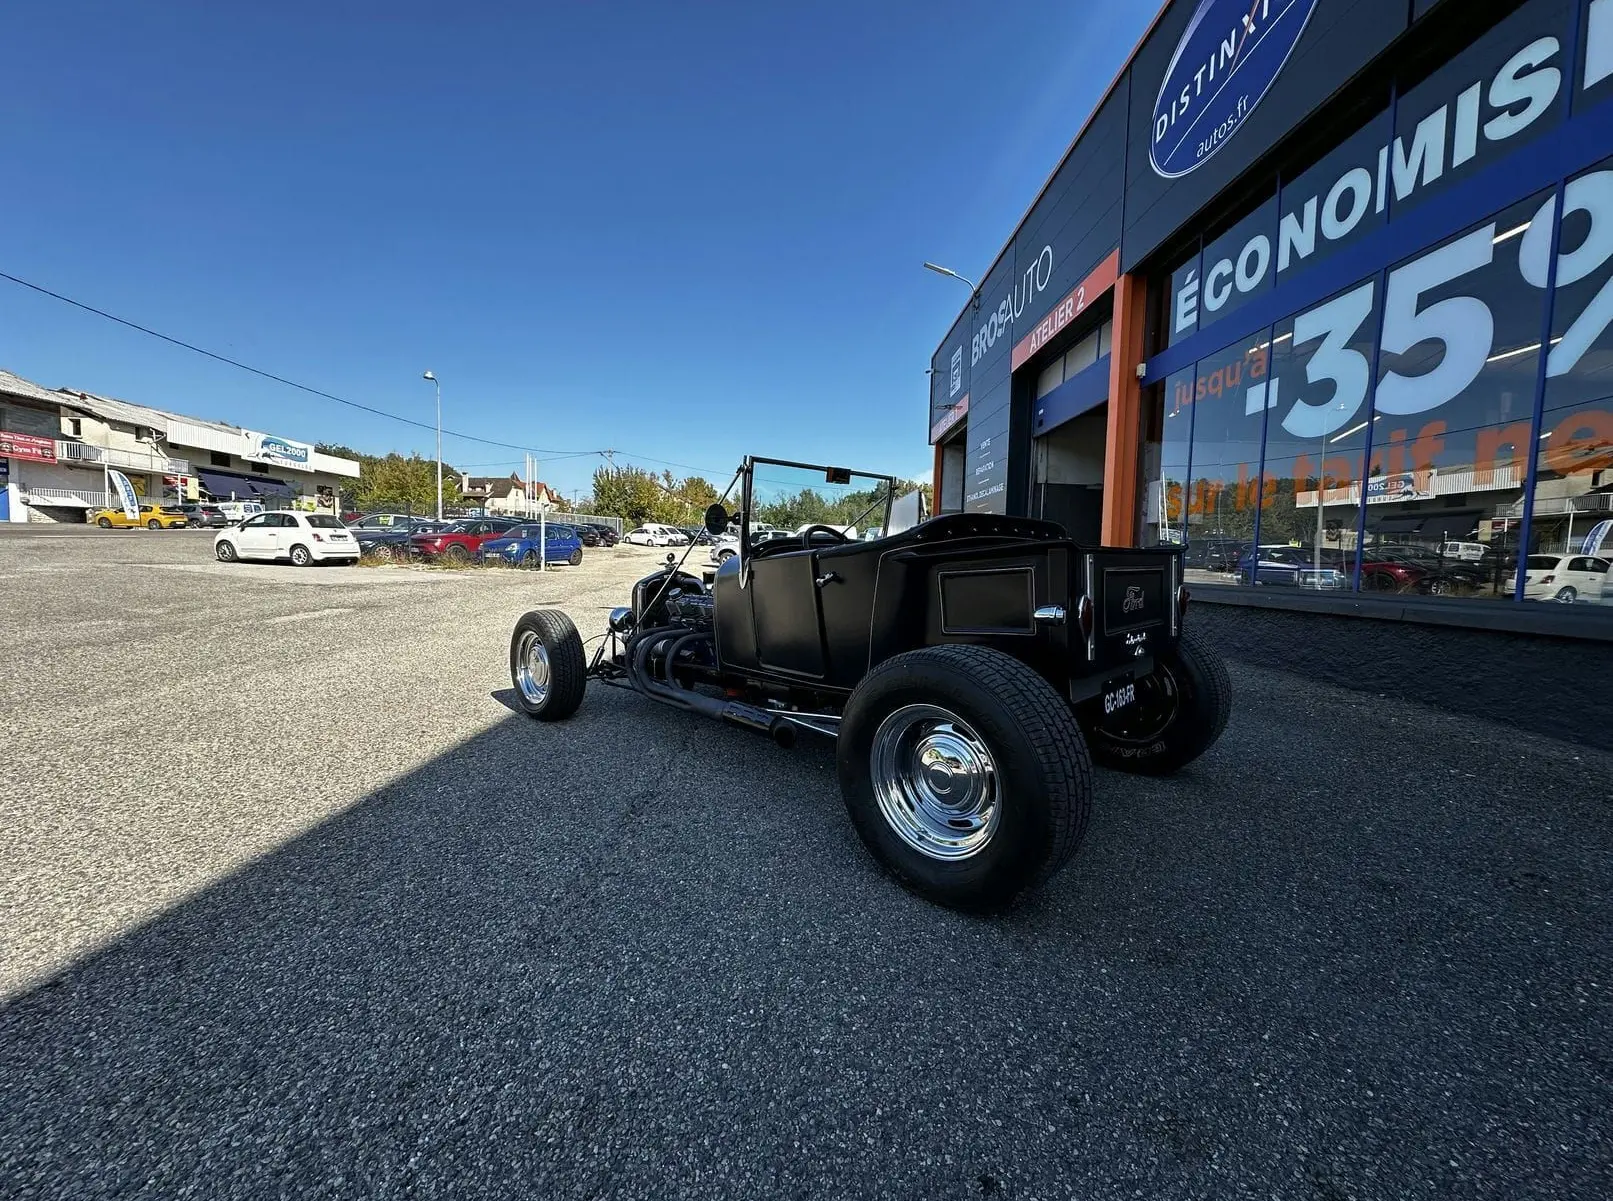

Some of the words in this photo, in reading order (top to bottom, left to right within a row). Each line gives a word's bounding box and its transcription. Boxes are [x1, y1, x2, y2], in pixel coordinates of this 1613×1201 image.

[1196, 94, 1249, 158] autos.fr
[1029, 297, 1074, 354] ATELIER
[1076, 286, 1086, 311] 2
[269, 443, 306, 458] GEL2000
[1167, 480, 1222, 520] sur
[1237, 463, 1277, 511] le
[1292, 420, 1447, 505] tarif
[1123, 586, 1145, 613] Ford
[1104, 683, 1135, 714] GC-163-FR
